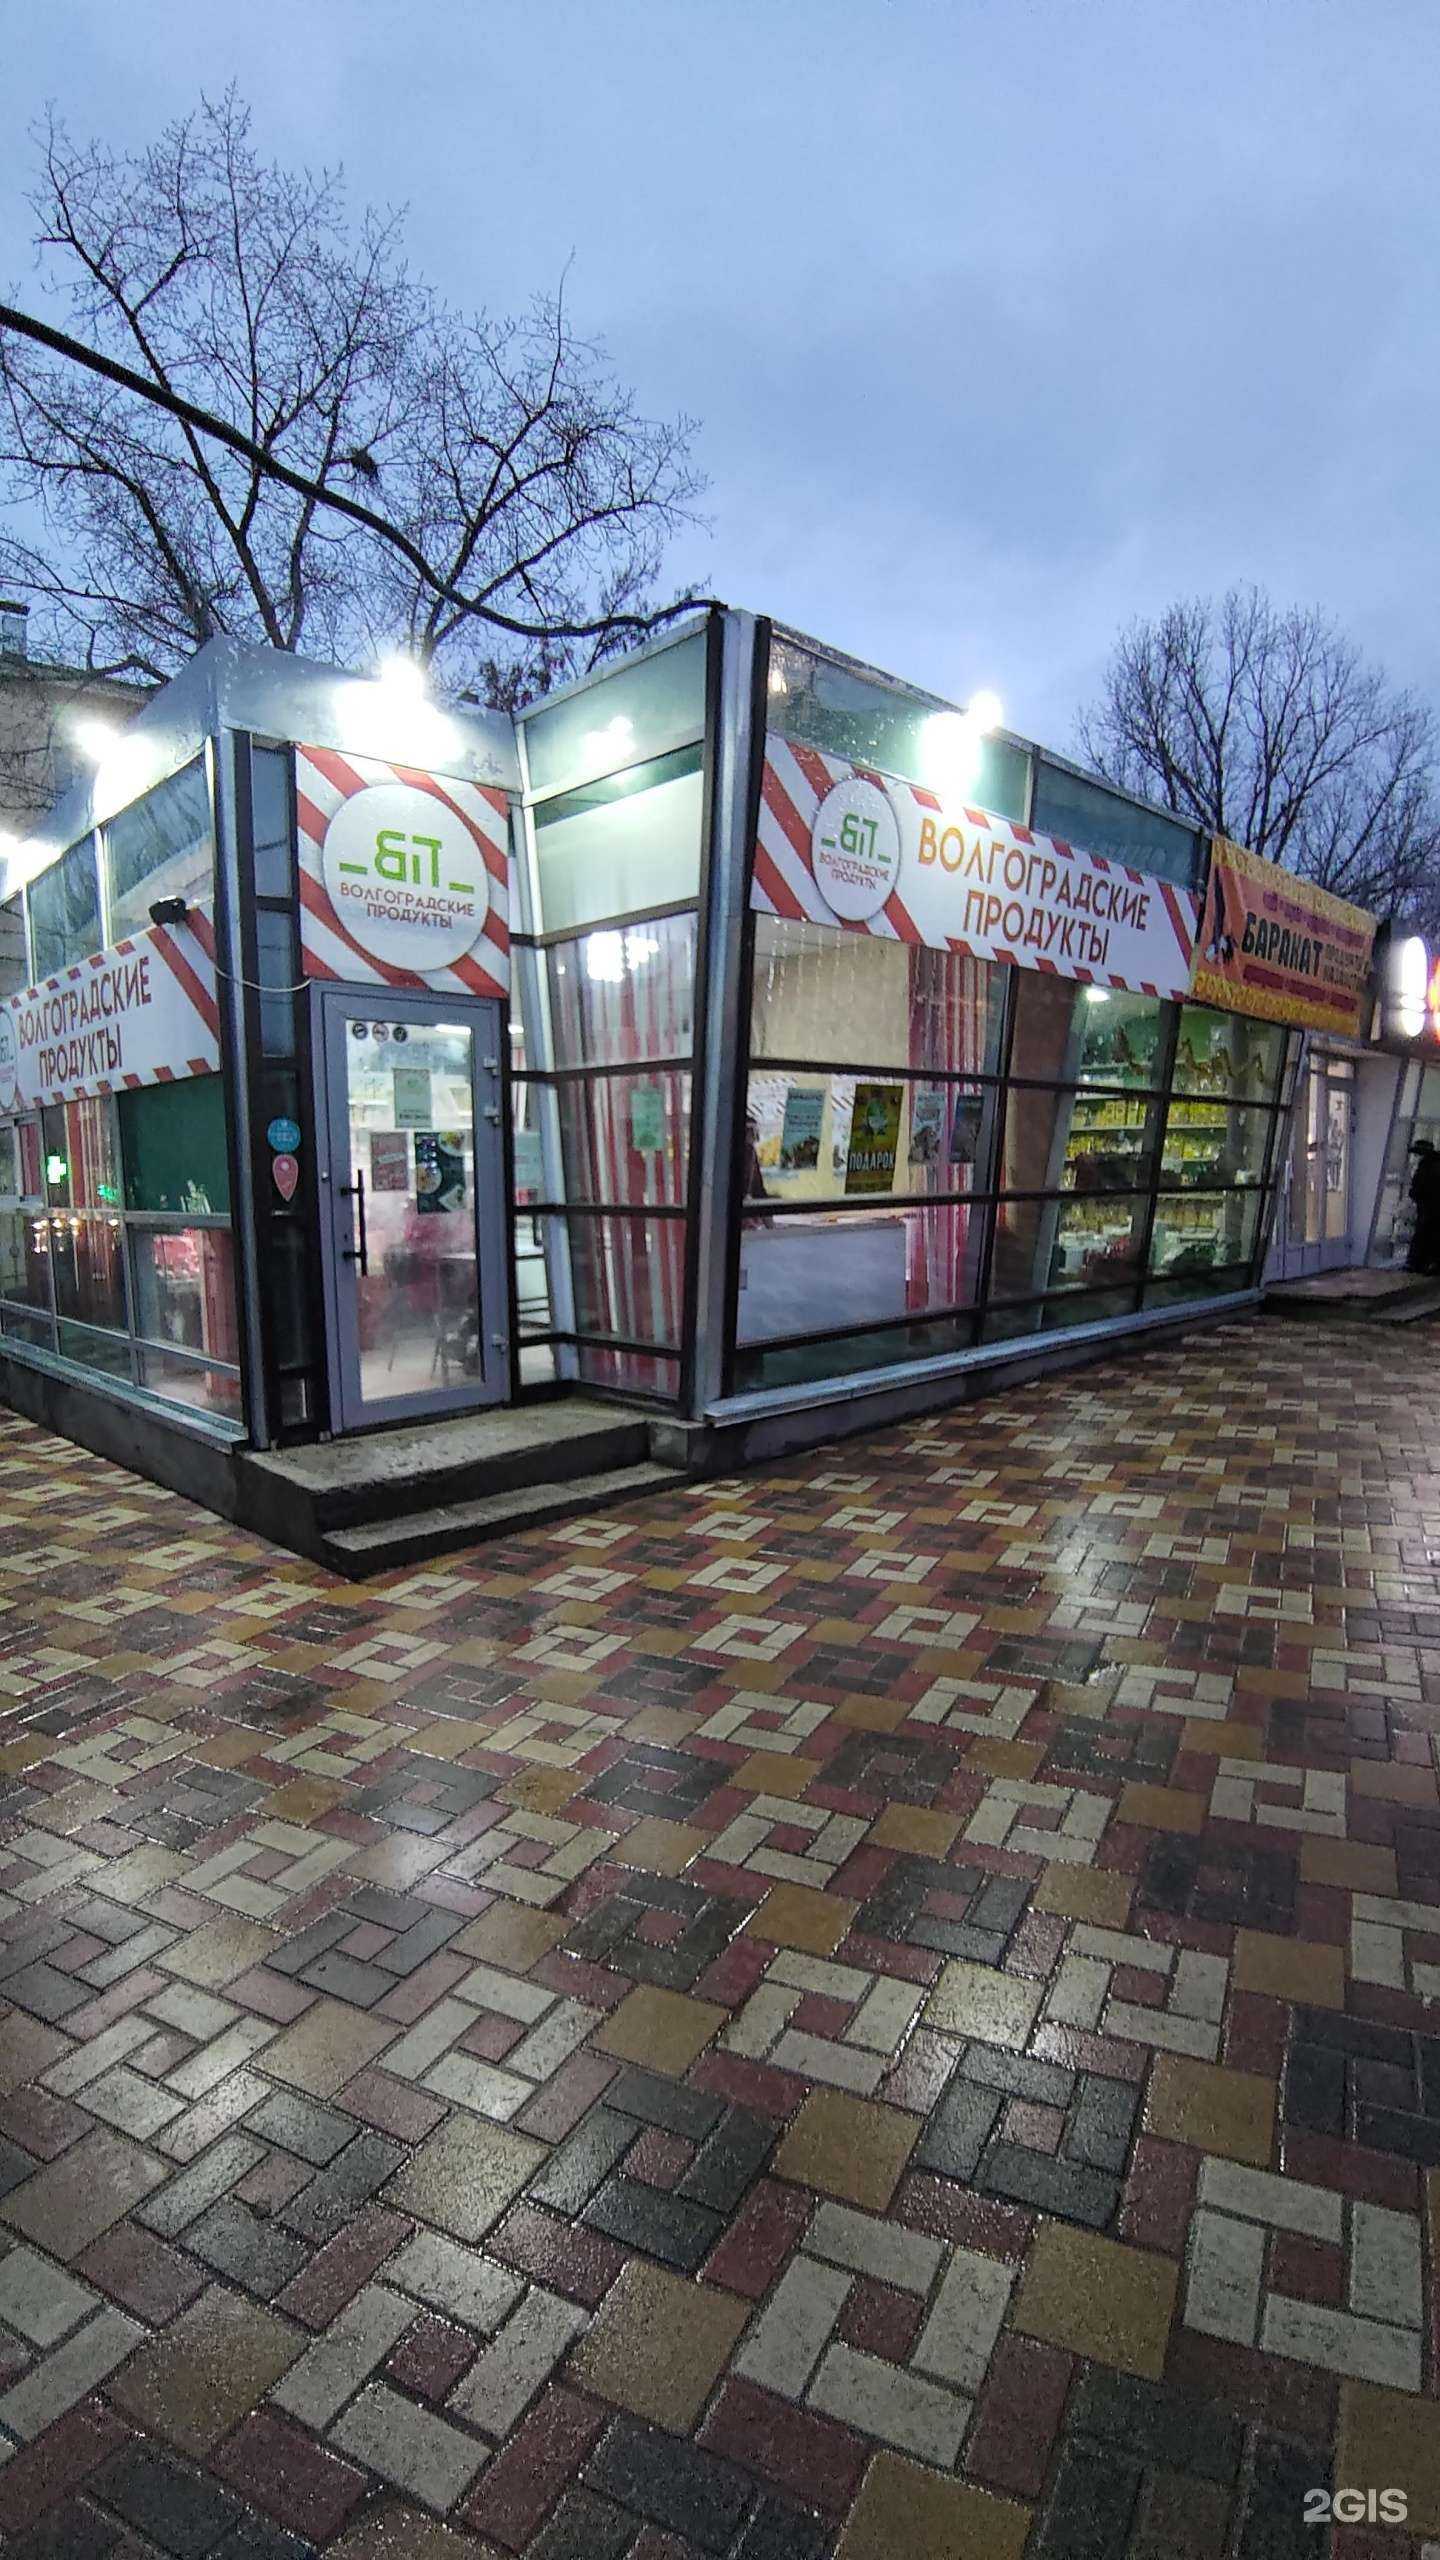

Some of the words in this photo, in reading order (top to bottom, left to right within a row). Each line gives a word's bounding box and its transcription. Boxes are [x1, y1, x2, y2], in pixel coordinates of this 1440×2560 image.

[339, 881, 476, 917] ВОЛГОГРАДСКИЕ
[918, 817, 1151, 932] ВОЛГОГРАДСКИЕ
[366, 902, 453, 930] ПРОДУКТЫ
[962, 888, 1110, 966] ПРОДУКТЫ
[1241, 911, 1324, 978] БАРАКАТ
[18, 955, 153, 1050] ВОЛГОГРАДСКИЕ
[38, 1023, 123, 1089] ПРОДУКТЫ
[848, 1150, 895, 1173] ПОДАРОК
